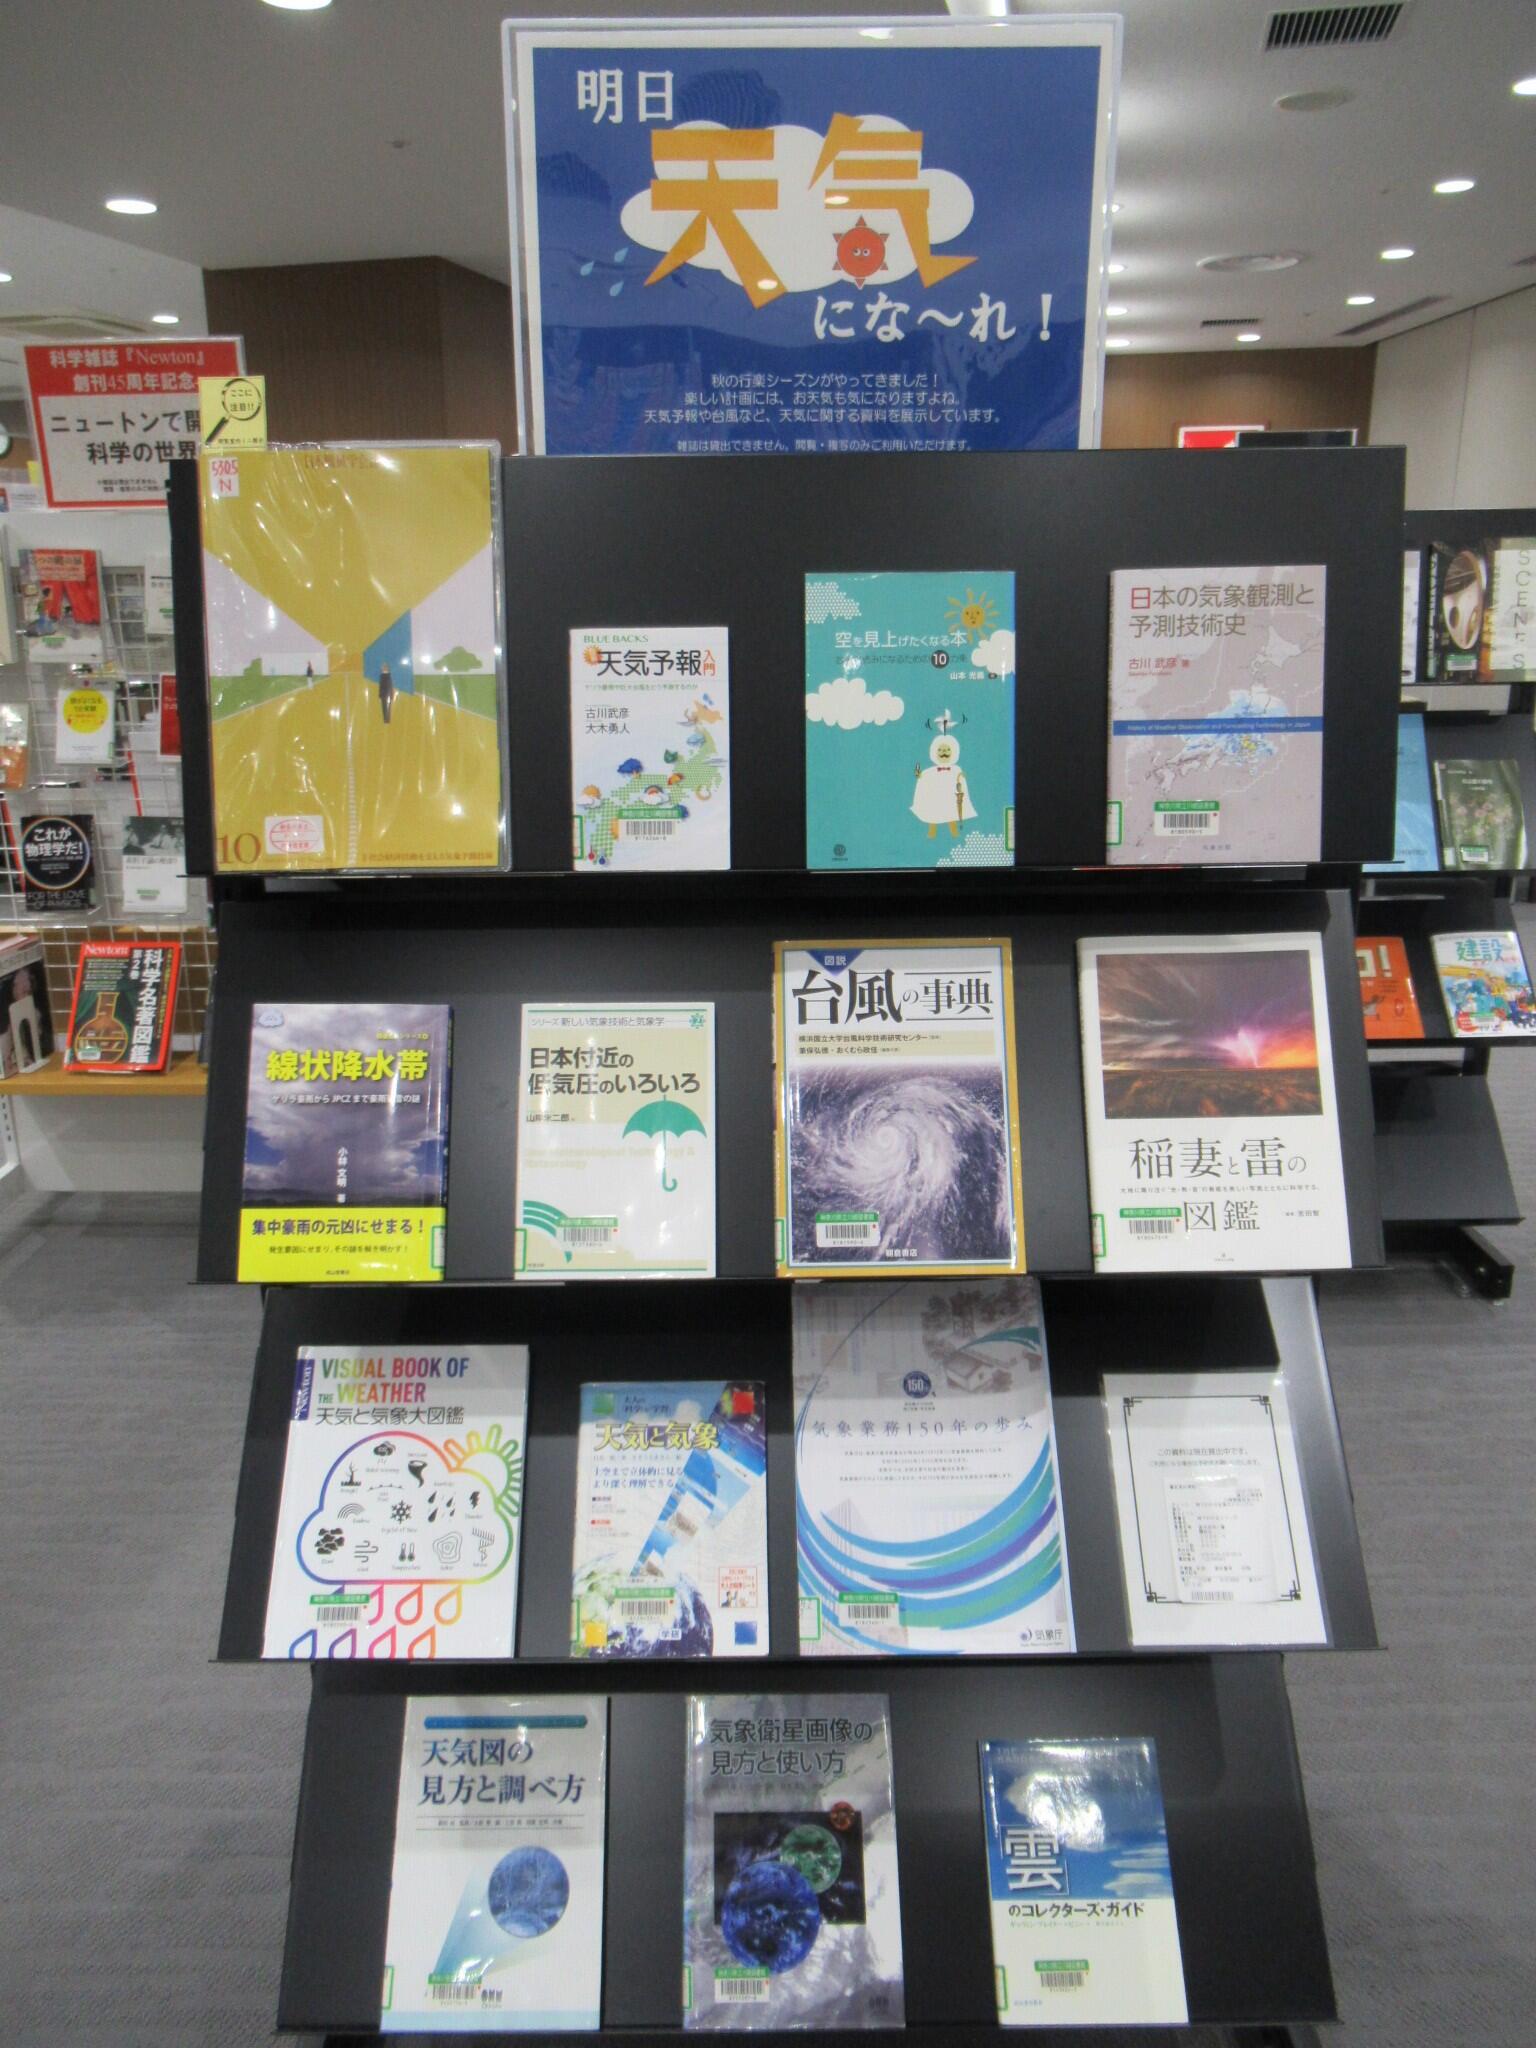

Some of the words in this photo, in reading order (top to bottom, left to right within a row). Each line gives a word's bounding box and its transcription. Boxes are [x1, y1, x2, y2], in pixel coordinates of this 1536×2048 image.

[577, 69, 674, 123] 明日
[644, 113, 979, 309] 天気
[73, 373, 200, 392] 創刊45周年記念
[87, 442, 197, 465] 科学の世界
[219, 479, 232, 492] N
[1131, 583, 1315, 609] 日本の気象観測と
[1129, 613, 1246, 638] 予測技術史
[612, 635, 649, 643] BACKS
[835, 630, 967, 648] 空を見上げたくなる本
[597, 650, 702, 676] 天気予報
[703, 649, 716, 677] 入門
[933, 653, 947, 665] 10
[1129, 656, 1151, 669] 古川
[585, 707, 630, 719] 古川武彦
[585, 722, 631, 734] 大木勇人
[34, 827, 72, 841] これが
[216, 832, 262, 865] 10
[792, 968, 994, 1025] 台風の事典
[266, 1049, 429, 1081] 線状降水帯
[530, 1046, 634, 1069] 日本付近の
[528, 1072, 701, 1096] 低気圧のいろいろ
[1128, 1136, 1307, 1180] 稲妻と雷の
[1183, 1199, 1260, 1232] 図鑑
[321, 1358, 386, 1379] VISUAL
[392, 1357, 442, 1378] BOOK
[446, 1357, 470, 1378] OF
[318, 1393, 334, 1404] THE
[336, 1382, 427, 1404] WEATHER
[315, 1406, 464, 1425] 天気と気象大図鑑
[812, 1415, 1033, 1438] 気象業務150年の歩み
[594, 1421, 719, 1451] 天気と気象
[710, 1718, 873, 1744] 気象衛星画像の
[421, 1737, 534, 1767] 天気図の
[710, 1750, 845, 1776] 見方と使い方
[416, 1774, 586, 1805] 見方と調べ方
[1005, 1828, 1064, 1891] 雲
[1008, 1902, 1145, 1918] のコレクターズ・ガイド
